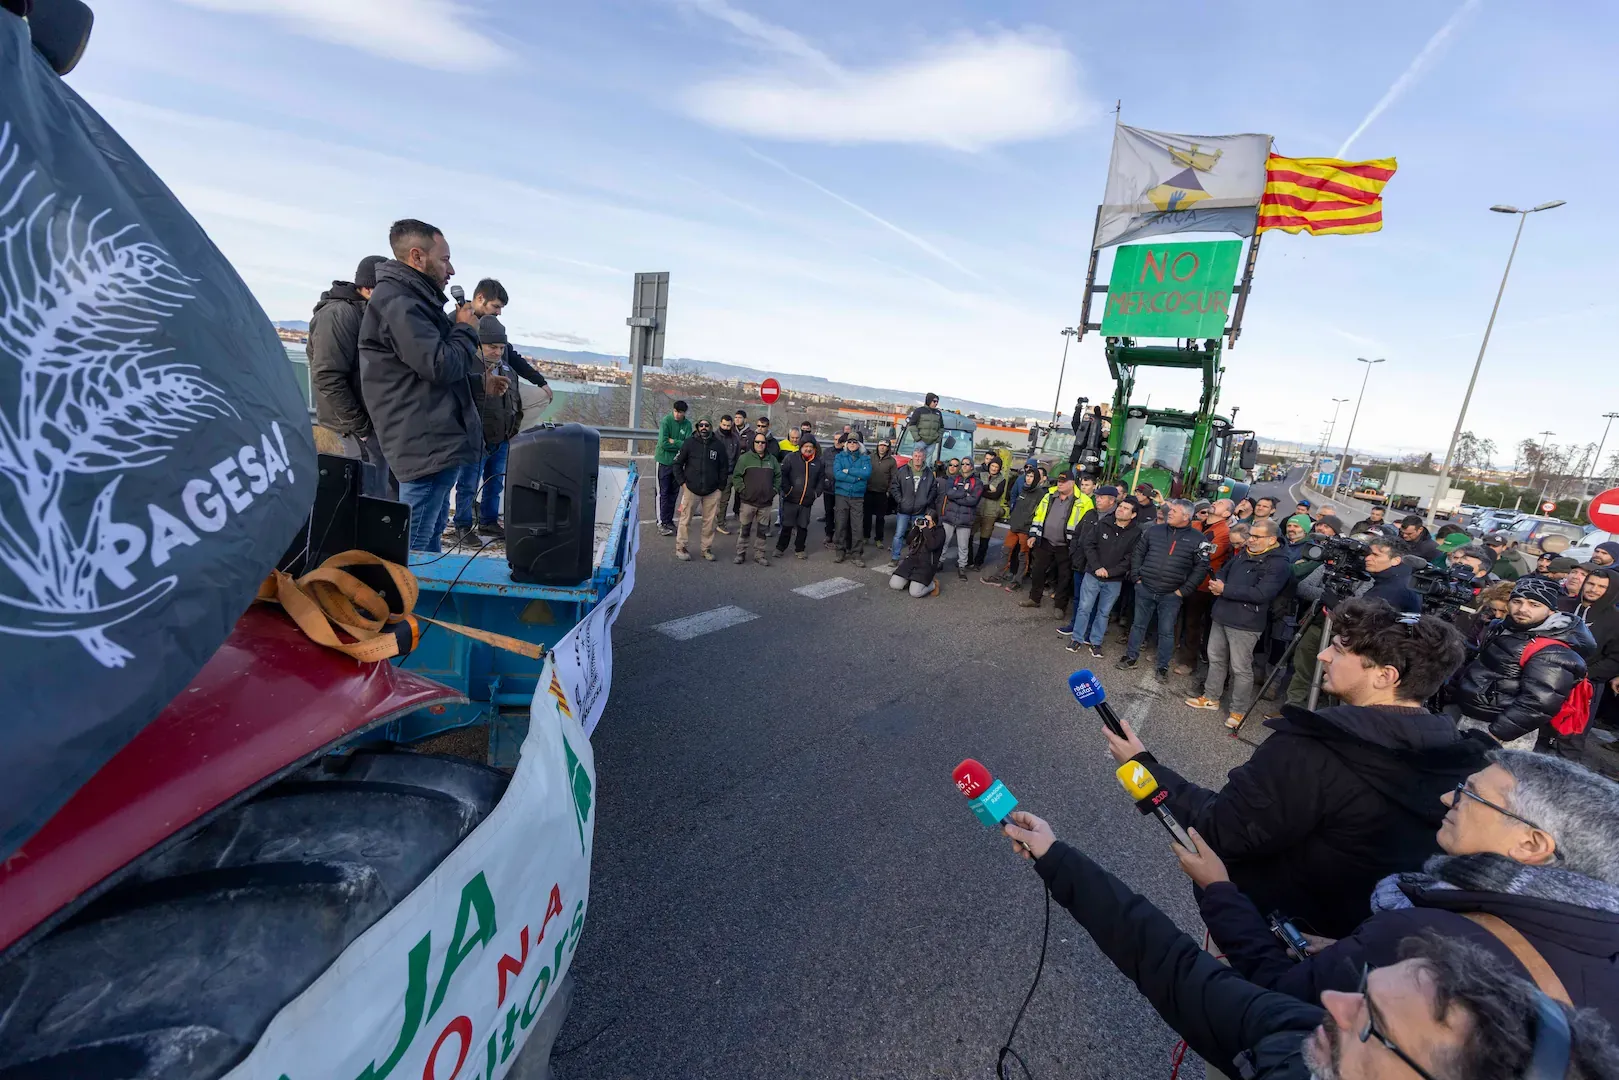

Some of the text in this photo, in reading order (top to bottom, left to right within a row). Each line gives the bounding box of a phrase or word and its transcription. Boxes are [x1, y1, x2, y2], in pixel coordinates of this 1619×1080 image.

[1140, 250, 1199, 283] NO
[1106, 290, 1228, 317] MERCOSUR
[97, 421, 295, 590] PAGESA!
